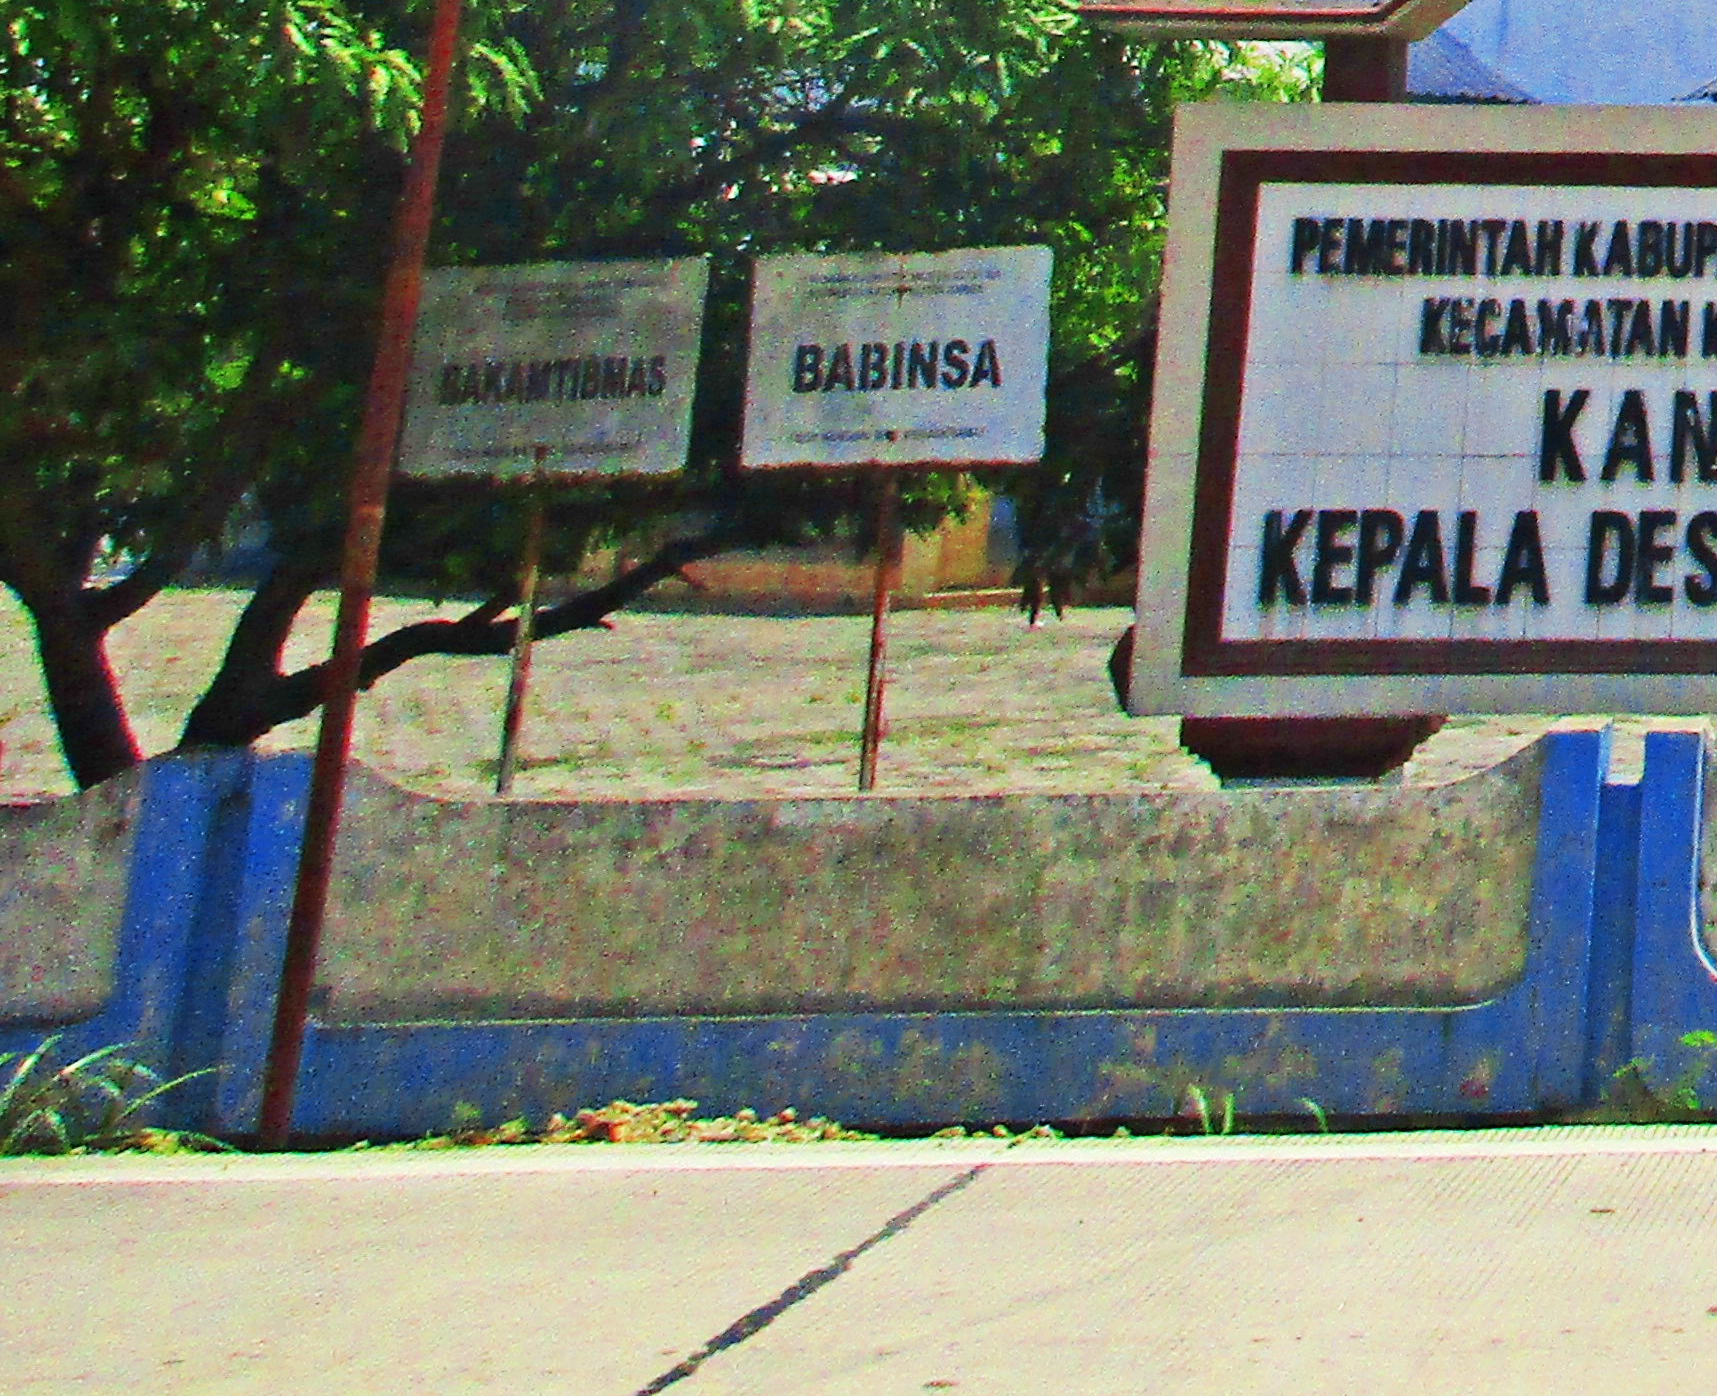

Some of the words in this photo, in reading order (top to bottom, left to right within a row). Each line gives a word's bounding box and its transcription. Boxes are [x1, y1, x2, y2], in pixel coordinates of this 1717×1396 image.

[1292, 218, 1564, 277] PEMERINTAH
[1420, 299, 1689, 360] KECAMATAN
[792, 339, 1002, 394] BABINSA
[1257, 507, 1551, 609] KEPALA
